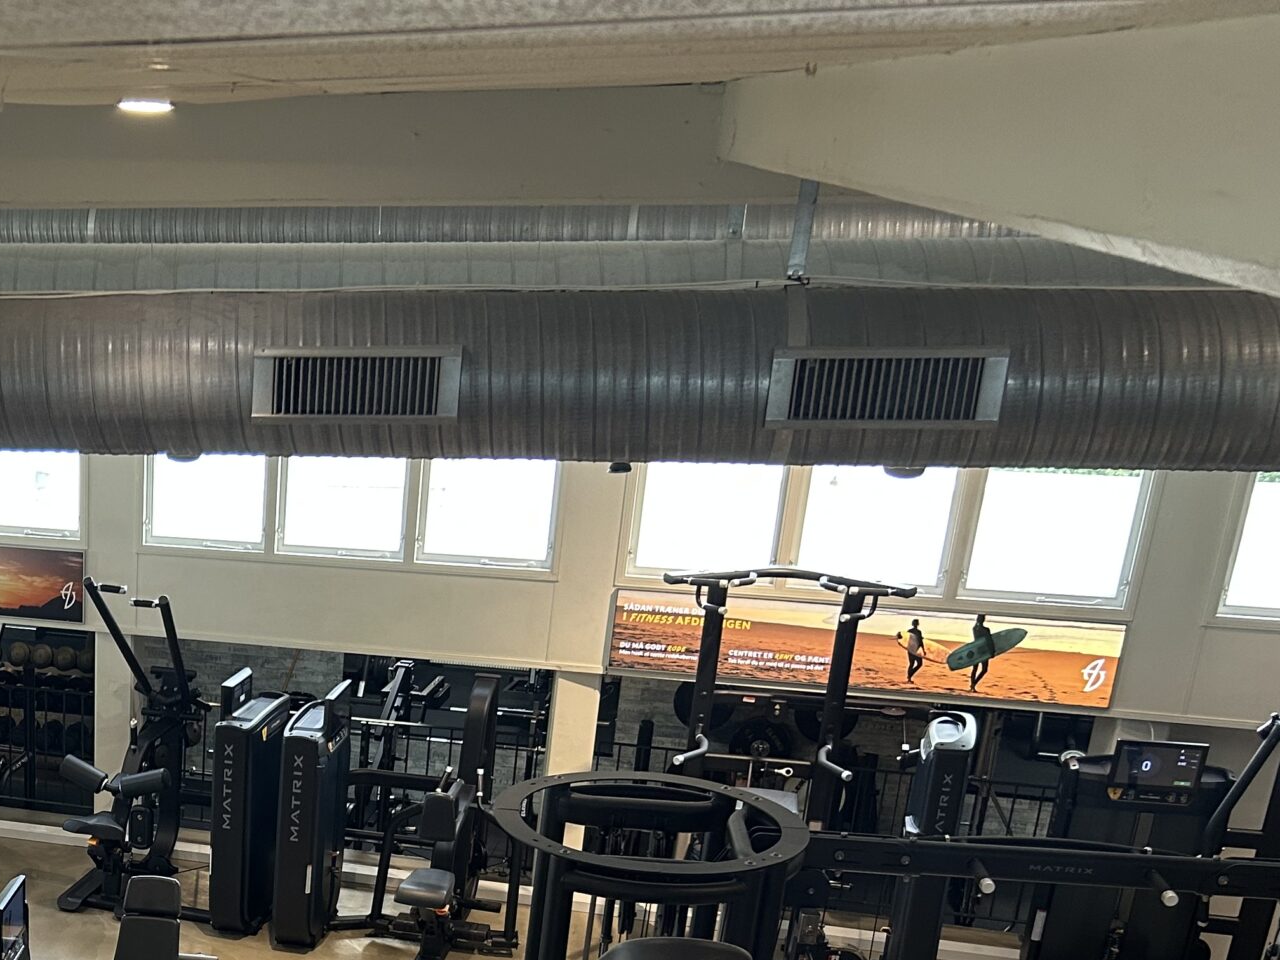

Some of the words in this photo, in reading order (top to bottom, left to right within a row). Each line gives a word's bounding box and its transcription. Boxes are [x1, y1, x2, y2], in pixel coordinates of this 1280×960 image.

[622, 612, 627, 621] I
[629, 613, 675, 624] FITNESS
[728, 649, 762, 658] CENTRET
[222, 744, 234, 829] MATRIX
[289, 755, 304, 842] MATRIX
[935, 773, 953, 833] ATRIX
[1029, 864, 1094, 875] MATRIX
